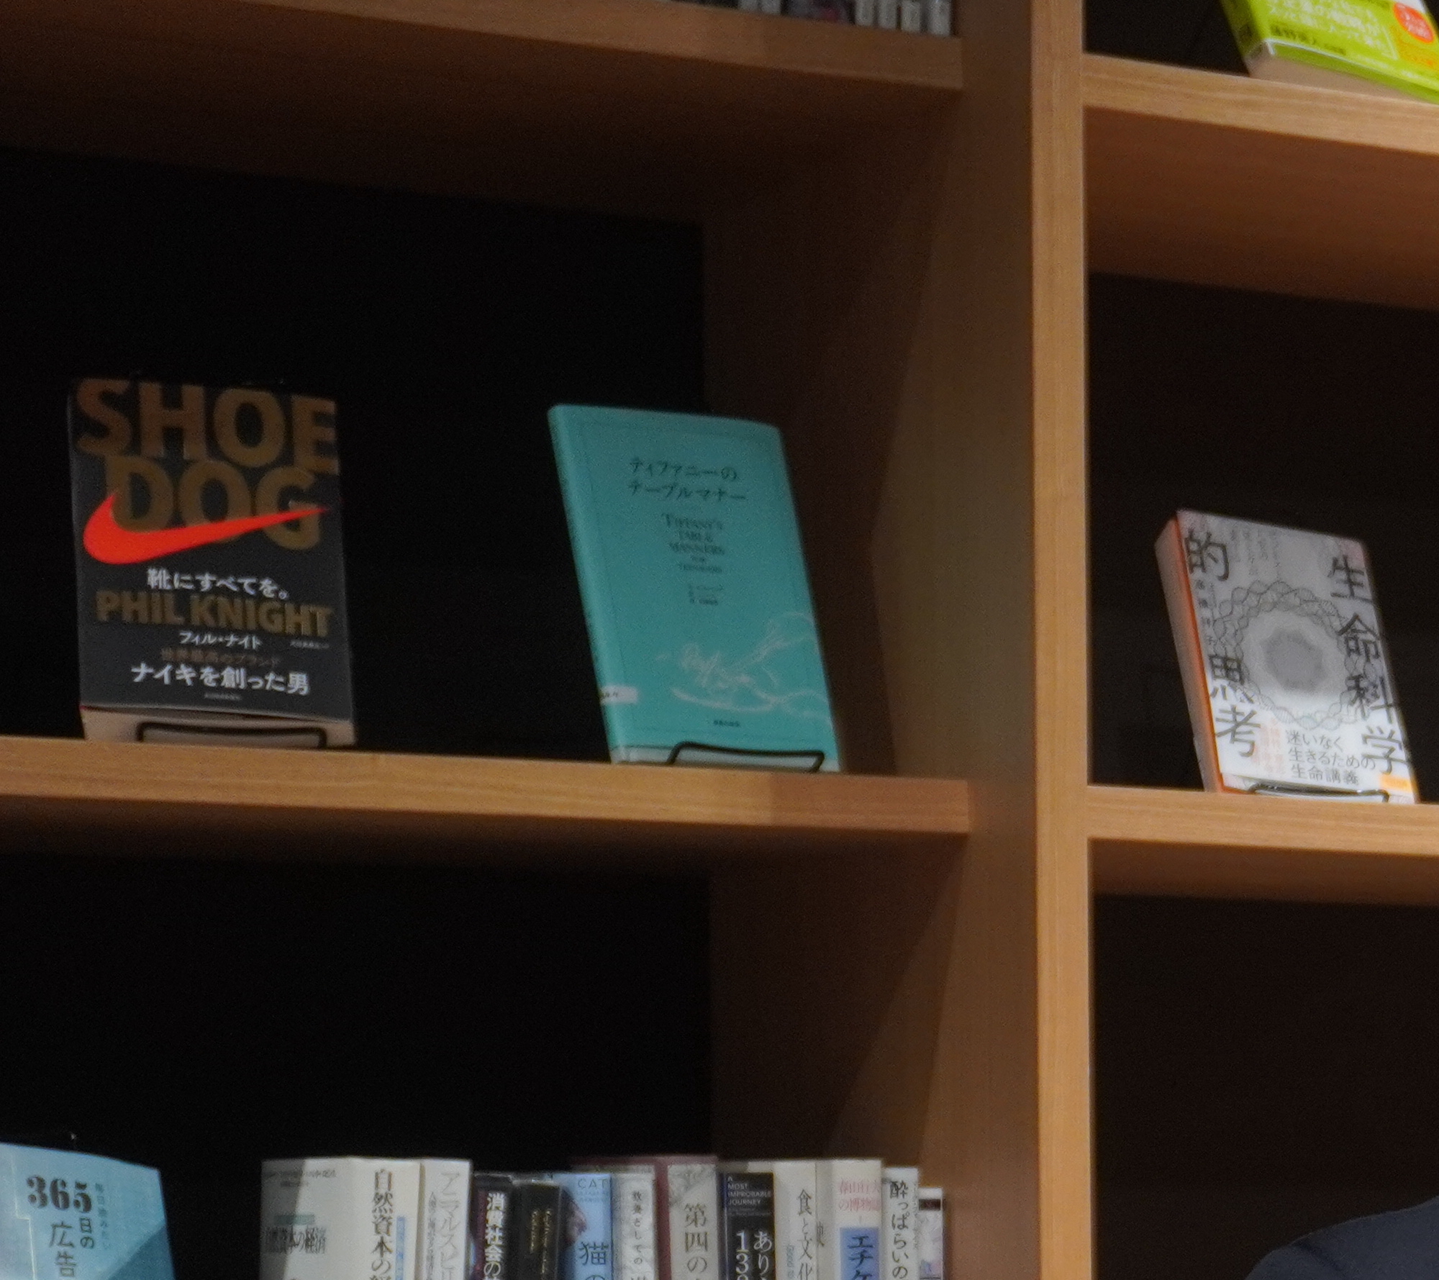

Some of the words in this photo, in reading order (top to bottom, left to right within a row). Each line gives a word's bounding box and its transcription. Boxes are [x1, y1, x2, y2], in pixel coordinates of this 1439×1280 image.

[76, 378, 339, 475] SHOE
[629, 456, 738, 481] ティファニーの
[104, 455, 321, 550] DOG
[627, 479, 747, 501] テーブルマナー
[147, 567, 290, 600] 靴にすべてを。
[95, 589, 186, 626] PHIL
[189, 595, 333, 638] KNIGHT
[179, 631, 263, 650] フィル・ナイト
[131, 662, 310, 696] ナイキを創った男
[1327, 554, 1408, 774] 生命科学
[1287, 729, 1343, 751] 迷いなく
[1288, 748, 1376, 772] 生きるための
[1291, 764, 1360, 785] 生命講義
[26, 1175, 93, 1213] 365
[79, 1217, 95, 1249] 日の
